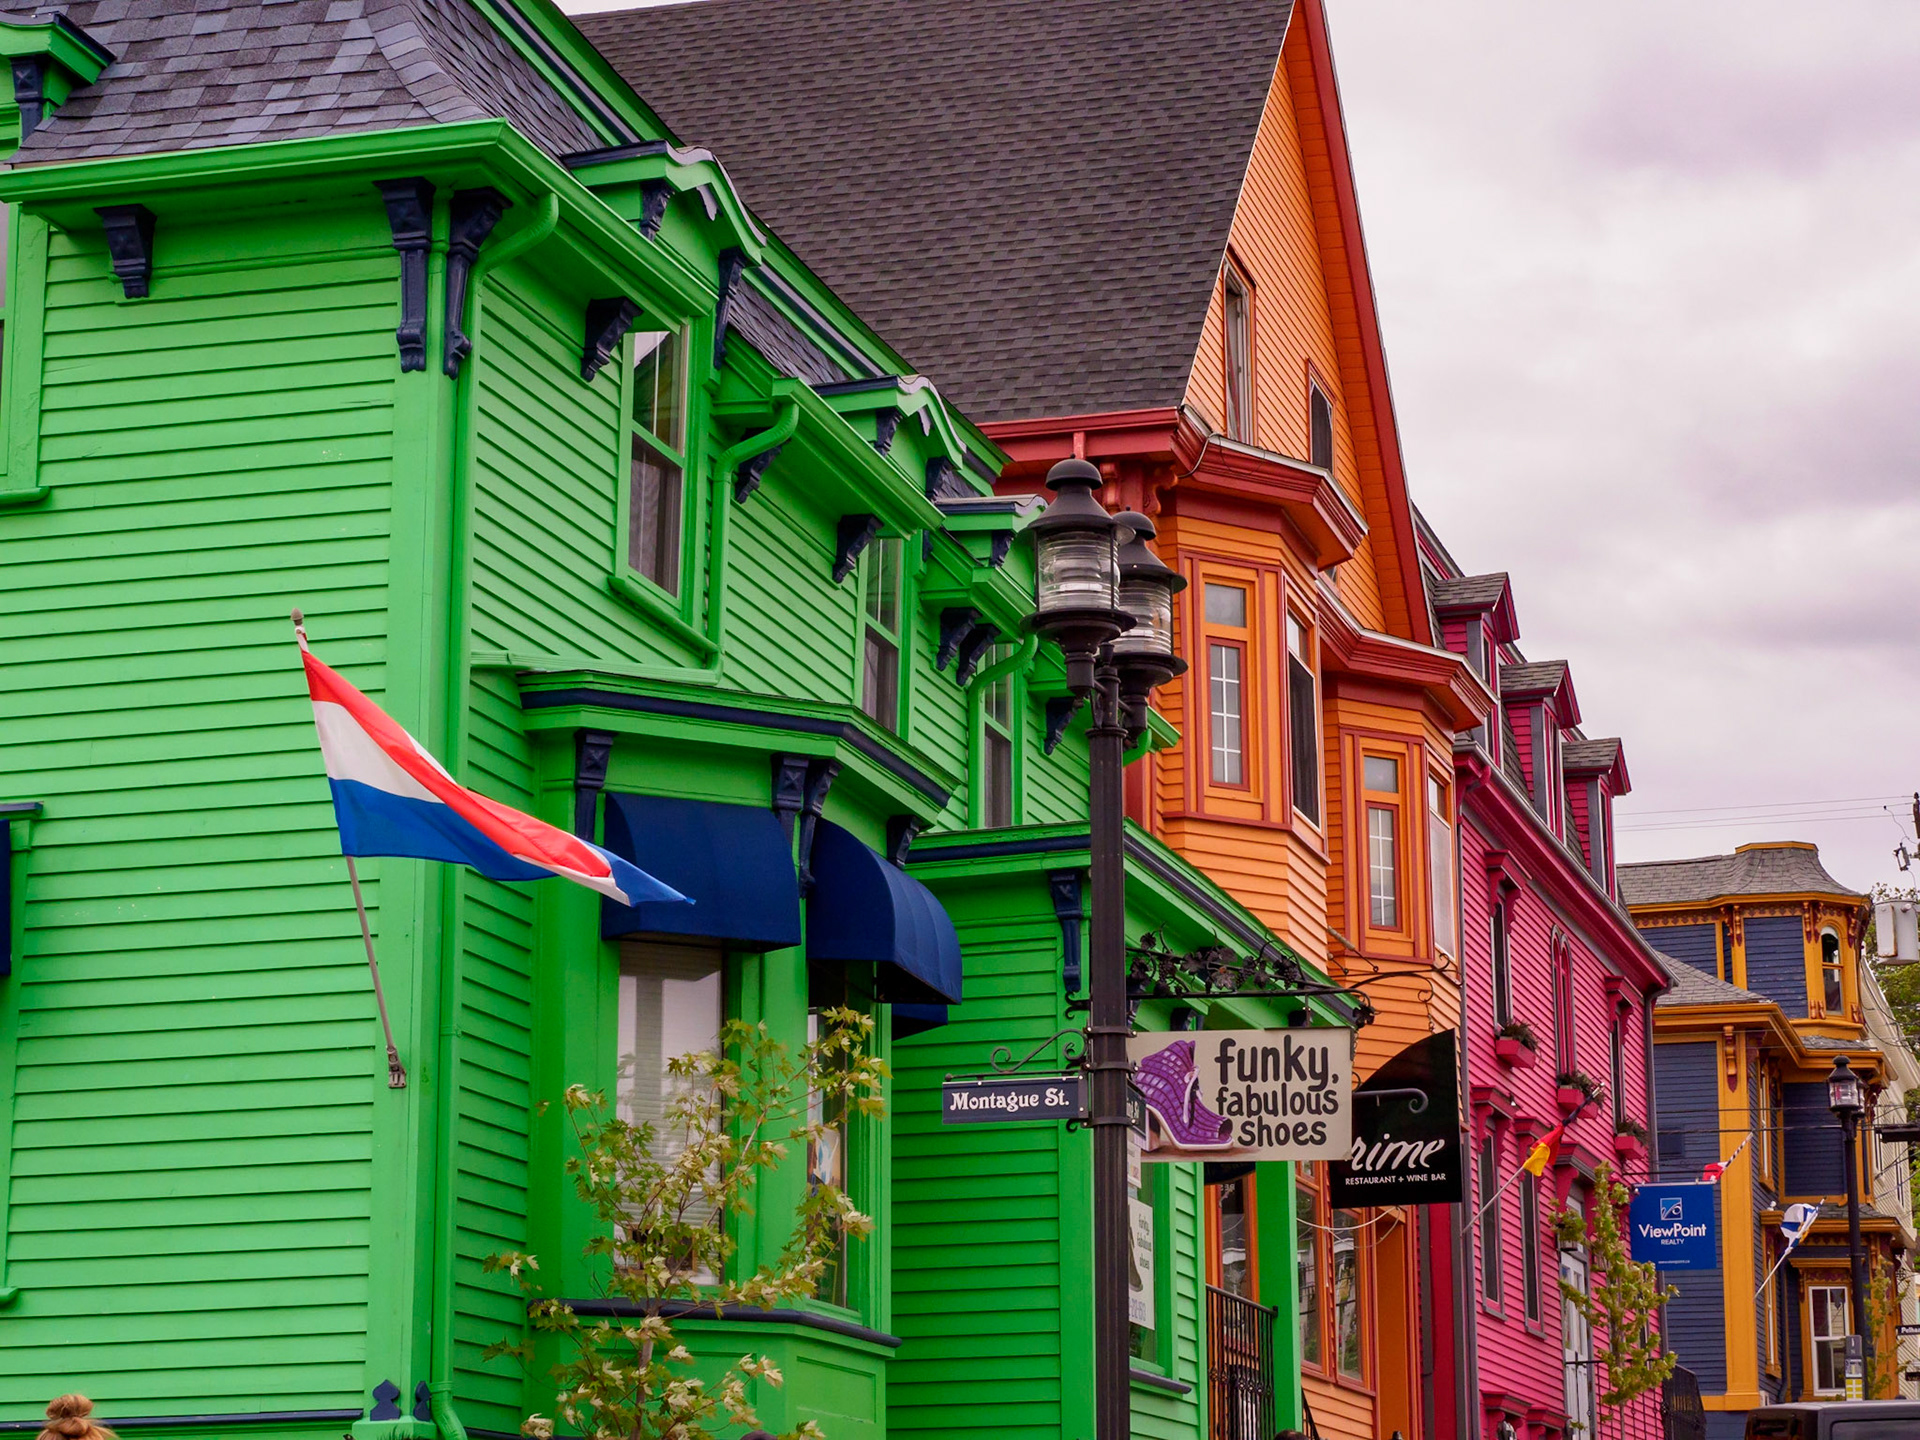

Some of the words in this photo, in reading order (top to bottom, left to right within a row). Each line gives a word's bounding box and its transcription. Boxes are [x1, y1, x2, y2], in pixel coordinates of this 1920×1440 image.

[1214, 1034, 1339, 1092] funky,
[950, 1091, 1039, 1112] Montague
[1044, 1088, 1070, 1106] St.
[1216, 1083, 1339, 1118] fabulous
[1350, 1133, 1446, 1171] rime
[1345, 1175, 1396, 1185] RESTAURANT
[1406, 1173, 1428, 1182] WINE
[1431, 1173, 1446, 1181] BAR
[1638, 1223, 1707, 1238] ViewPoint
[1901, 1326, 1920, 1335] Pelha
